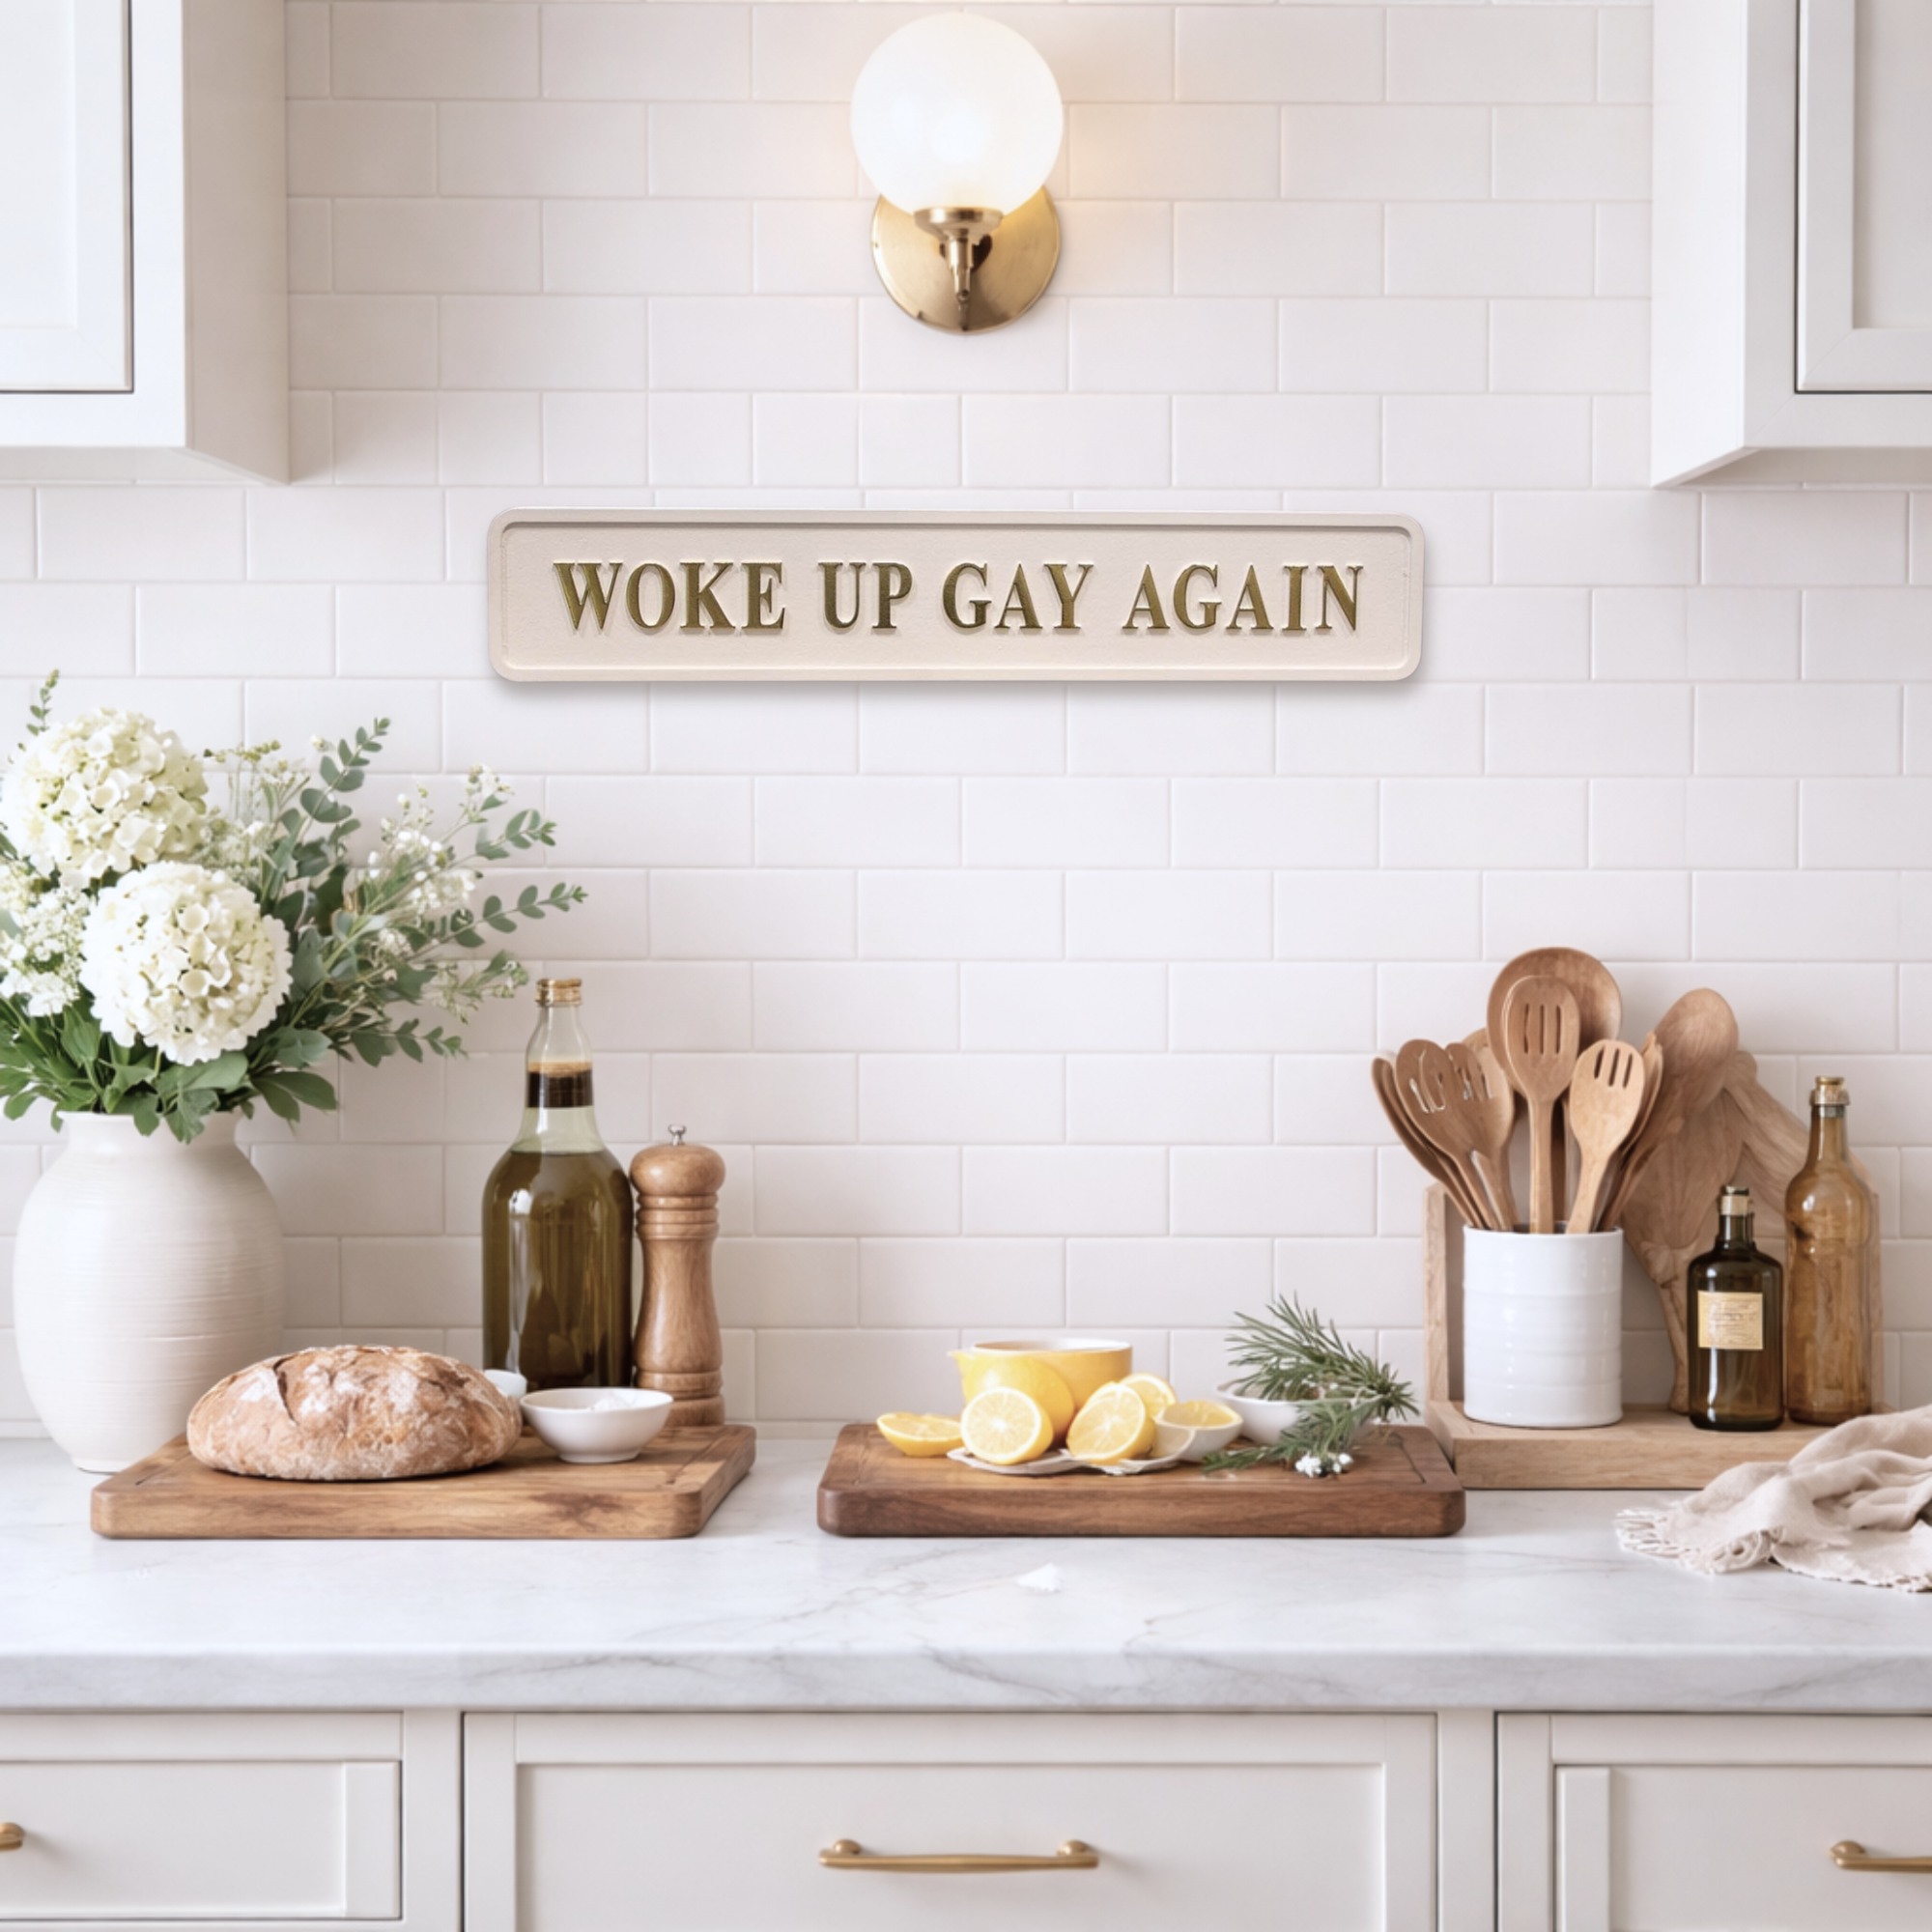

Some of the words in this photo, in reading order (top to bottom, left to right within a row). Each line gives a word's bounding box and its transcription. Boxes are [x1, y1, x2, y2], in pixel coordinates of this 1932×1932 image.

[553, 561, 785, 631] WOKE
[817, 561, 913, 630] UP
[942, 562, 1094, 630] GAY
[1122, 563, 1363, 631] AGAIN
